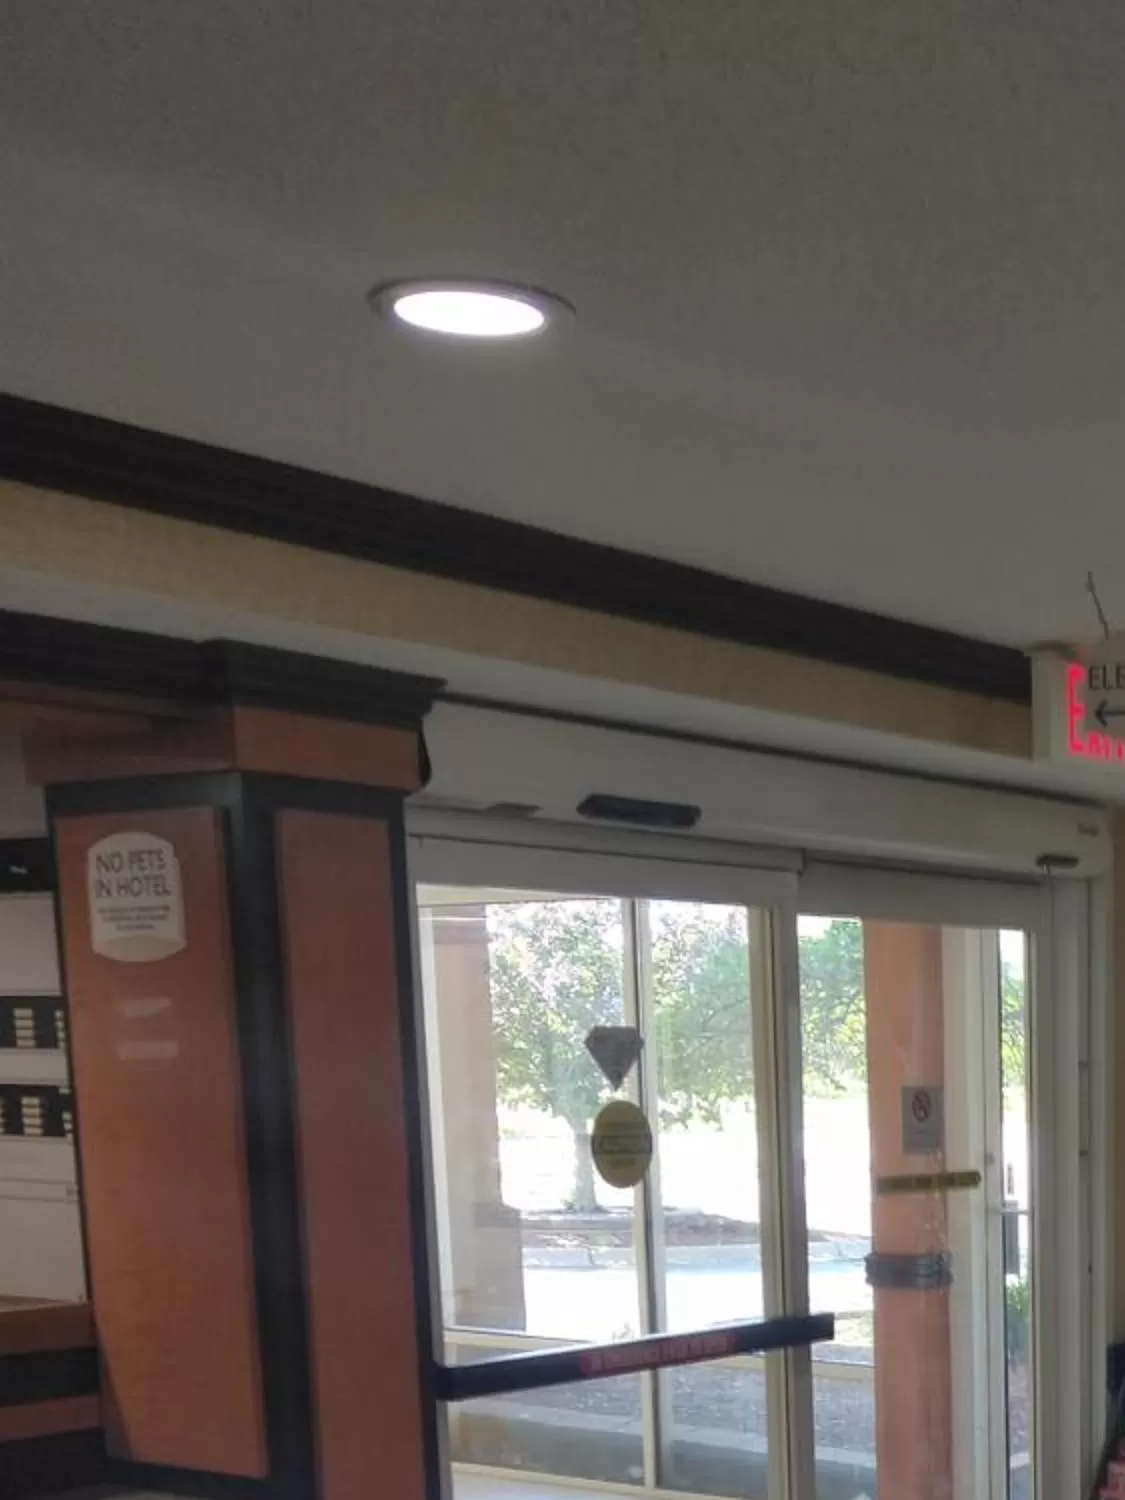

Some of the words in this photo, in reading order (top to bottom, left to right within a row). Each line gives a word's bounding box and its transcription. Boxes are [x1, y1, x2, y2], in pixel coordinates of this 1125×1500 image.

[96, 851, 124, 873] NO
[128, 848, 167, 871] PETS
[95, 879, 113, 898] IN
[117, 875, 172, 897] HOTEL
